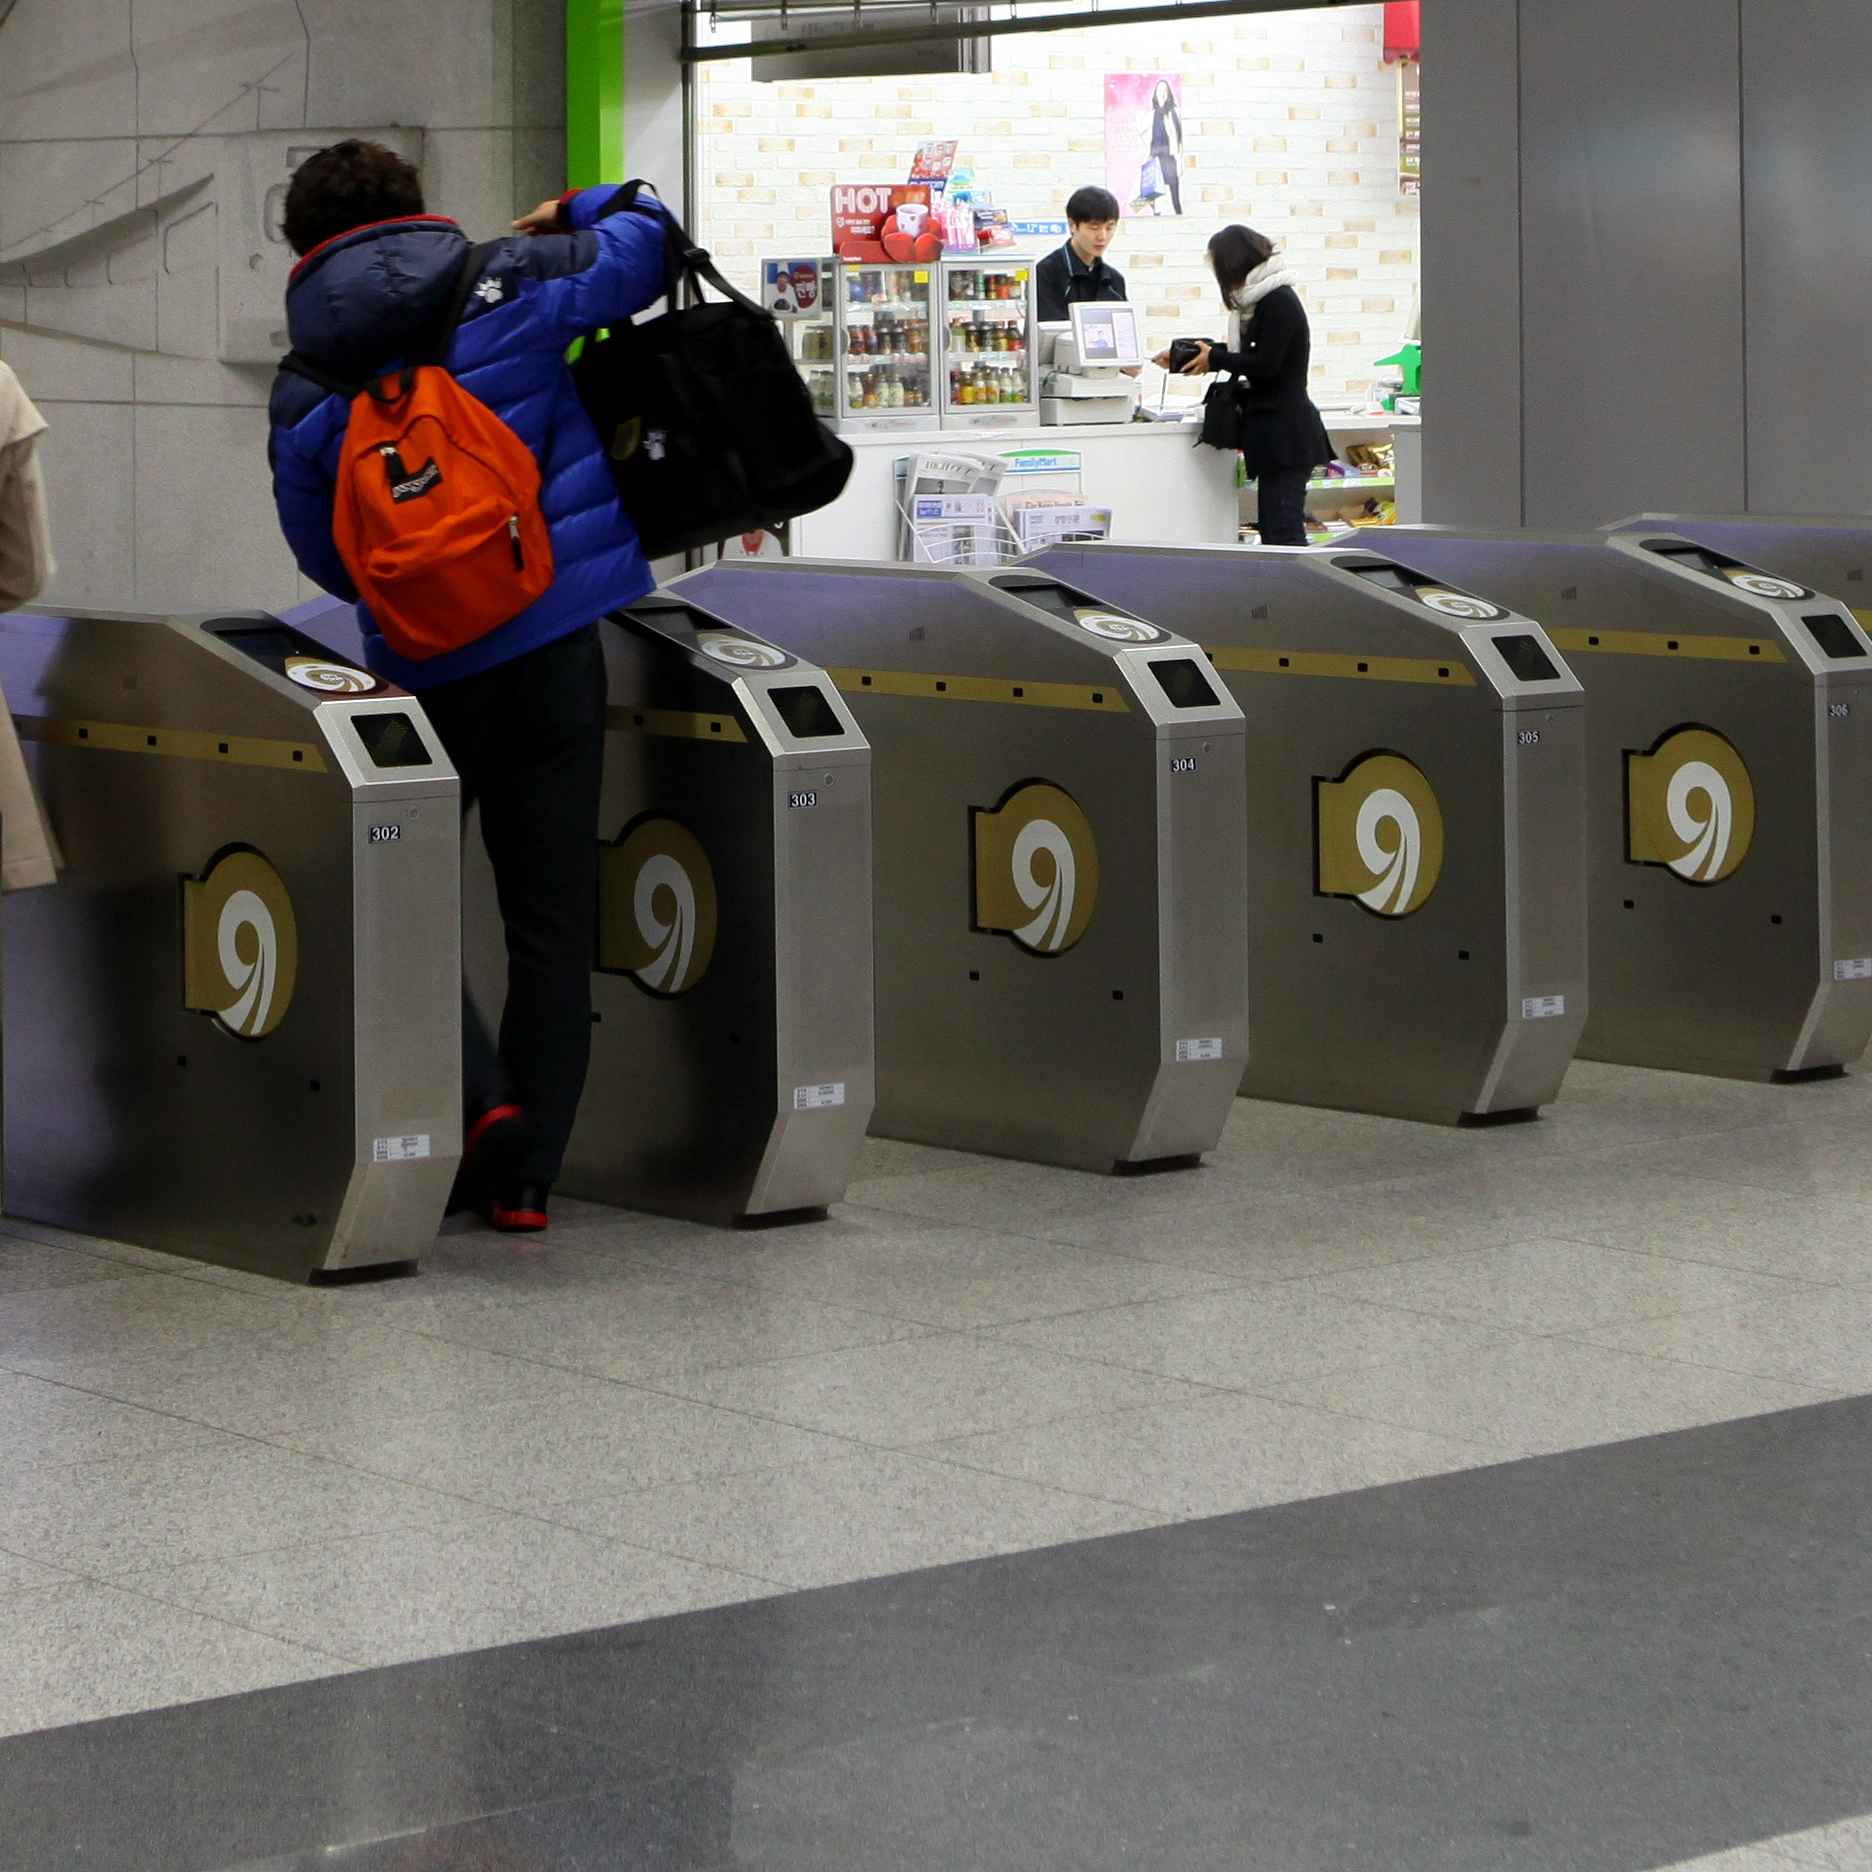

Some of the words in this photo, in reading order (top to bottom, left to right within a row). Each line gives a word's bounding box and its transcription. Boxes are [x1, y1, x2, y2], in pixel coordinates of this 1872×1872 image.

[835, 188, 891, 214] HOT
[1015, 458, 1057, 469] FamilyMart
[1518, 730, 1539, 744] 305
[1172, 758, 1195, 772] 304
[790, 792, 816, 808] 303
[372, 825, 399, 841] 302
